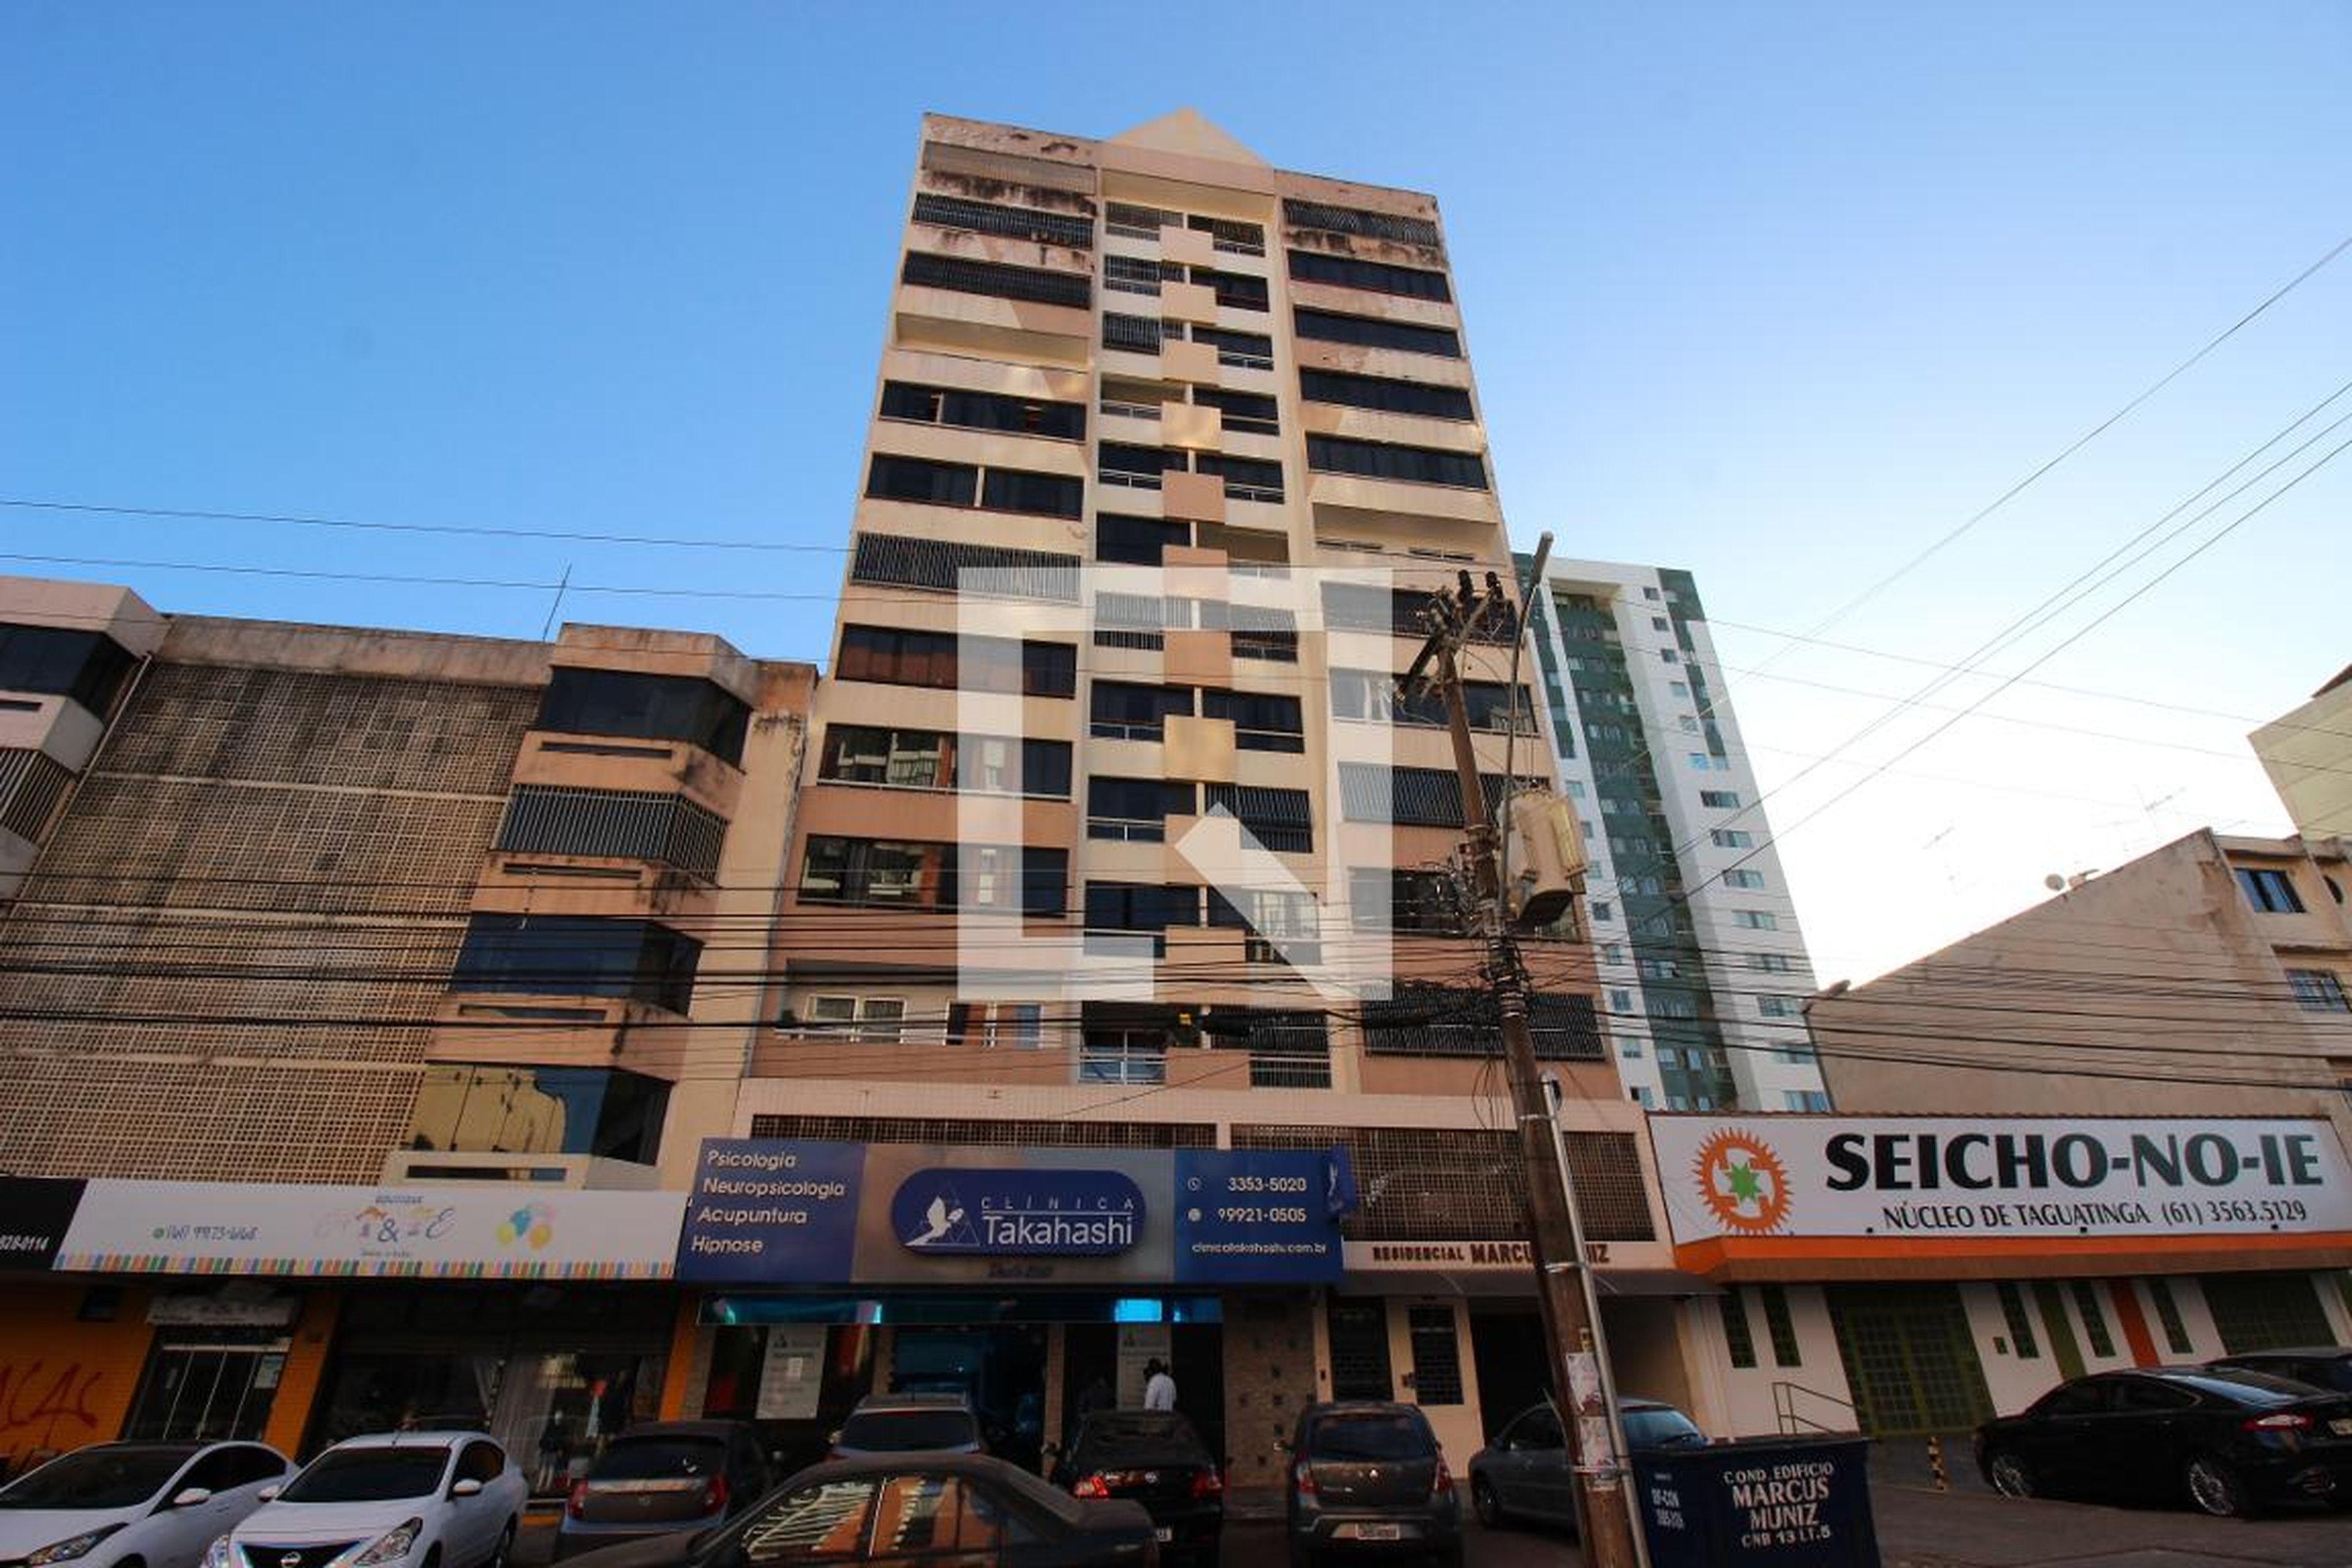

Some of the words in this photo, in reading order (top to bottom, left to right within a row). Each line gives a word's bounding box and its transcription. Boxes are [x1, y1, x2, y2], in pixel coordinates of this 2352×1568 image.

[707, 1149, 797, 1170] Psicologia
[1825, 1133, 2323, 1191] SEICHO-NO-IE
[703, 1177, 845, 1199] Neuropsicologia
[696, 1207, 807, 1226] Acupuntura
[1218, 1208, 1306, 1222] 99921-0505
[1882, 1201, 1975, 1230] NÚCLEO
[1981, 1204, 2012, 1227] DE
[2015, 1202, 2151, 1227] TAGUATINGA
[2162, 1202, 2203, 1226] (61)
[2210, 1200, 2307, 1223] 3563.5129
[982, 1216, 1133, 1245] Takahashi
[691, 1234, 763, 1254] Hipnose
[1373, 1246, 1465, 1261] RESIDENCIAL
[1471, 1243, 1532, 1263] MARCU
[1733, 1477, 1830, 1509] MARCUS
[1750, 1502, 1819, 1530] MUNIZ
